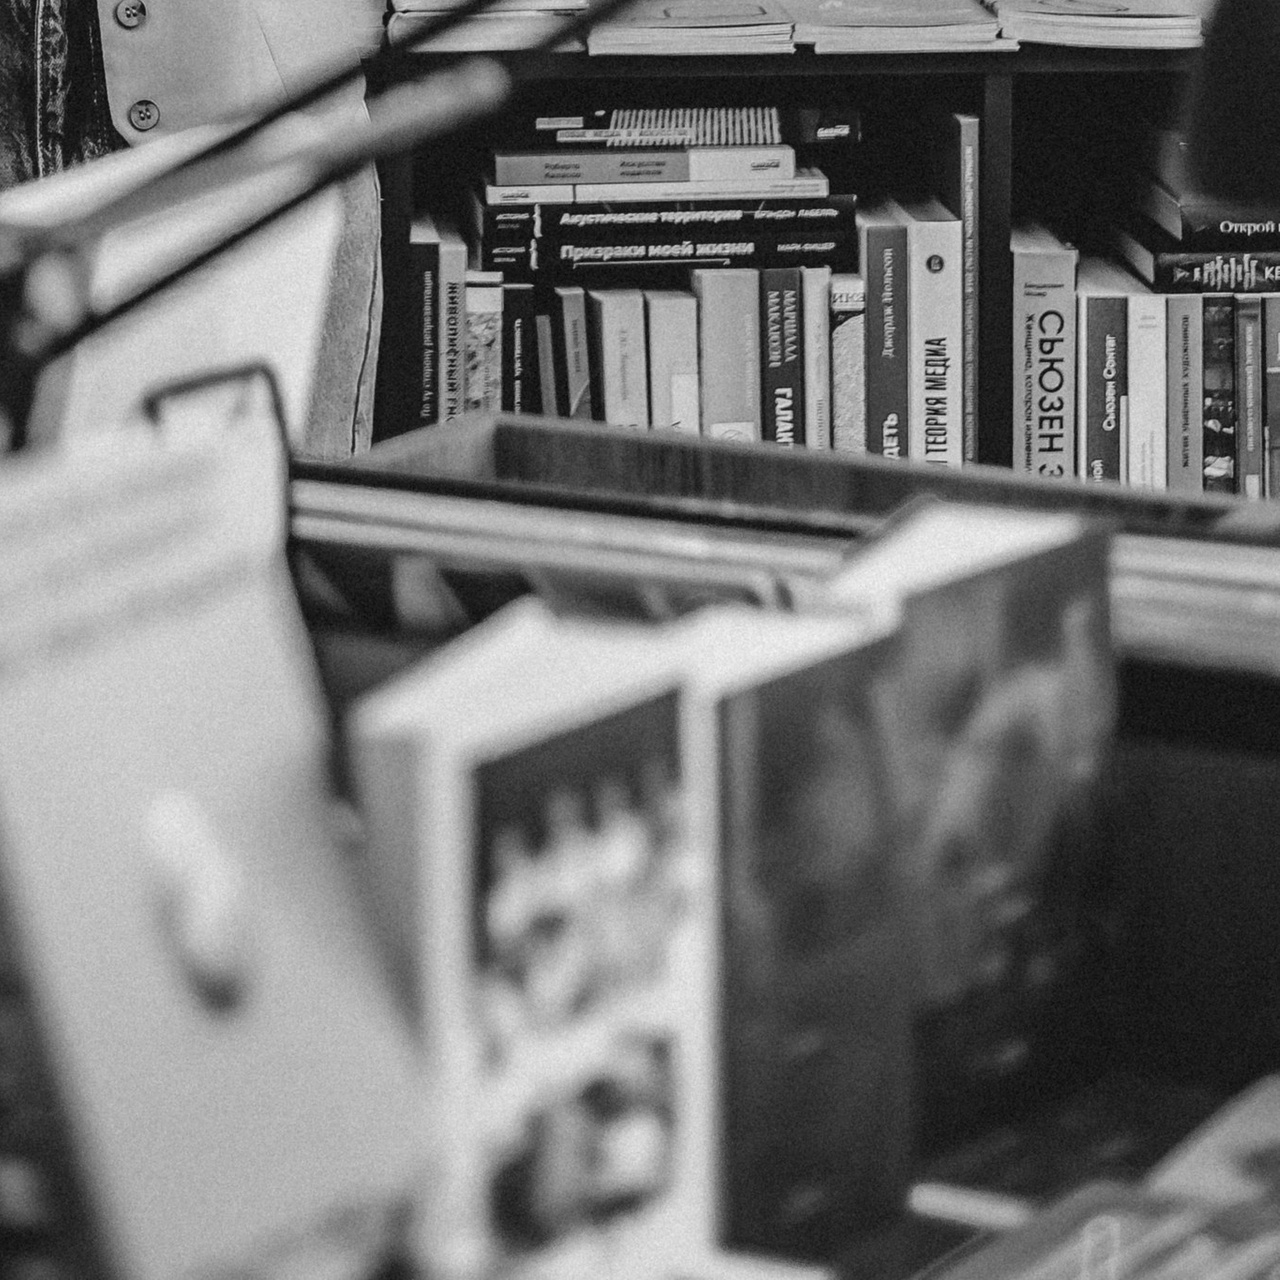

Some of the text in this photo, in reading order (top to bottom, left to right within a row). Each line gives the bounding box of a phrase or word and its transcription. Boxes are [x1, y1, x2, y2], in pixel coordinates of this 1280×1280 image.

[559, 212, 659, 226] Акустические
[660, 209, 743, 224] территории
[1219, 219, 1275, 237] Открой
[560, 244, 646, 261] Призраки
[648, 240, 694, 256] моей
[695, 242, 755, 255] жизни
[767, 290, 782, 368] МАКЛЮЭН
[782, 290, 797, 363] МАРШАЛЛ
[881, 304, 895, 357] Джордж
[422, 348, 433, 389] сторону
[1039, 309, 1065, 453] СЬЮЗЕН
[1102, 334, 1117, 431] Сьюзен Сонтаг
[423, 390, 434, 402] ту
[924, 337, 950, 455] ТЕОРИЯ МЕДИА
[882, 412, 900, 459] ДЕТЬ
[1025, 424, 1034, 475] изменил
